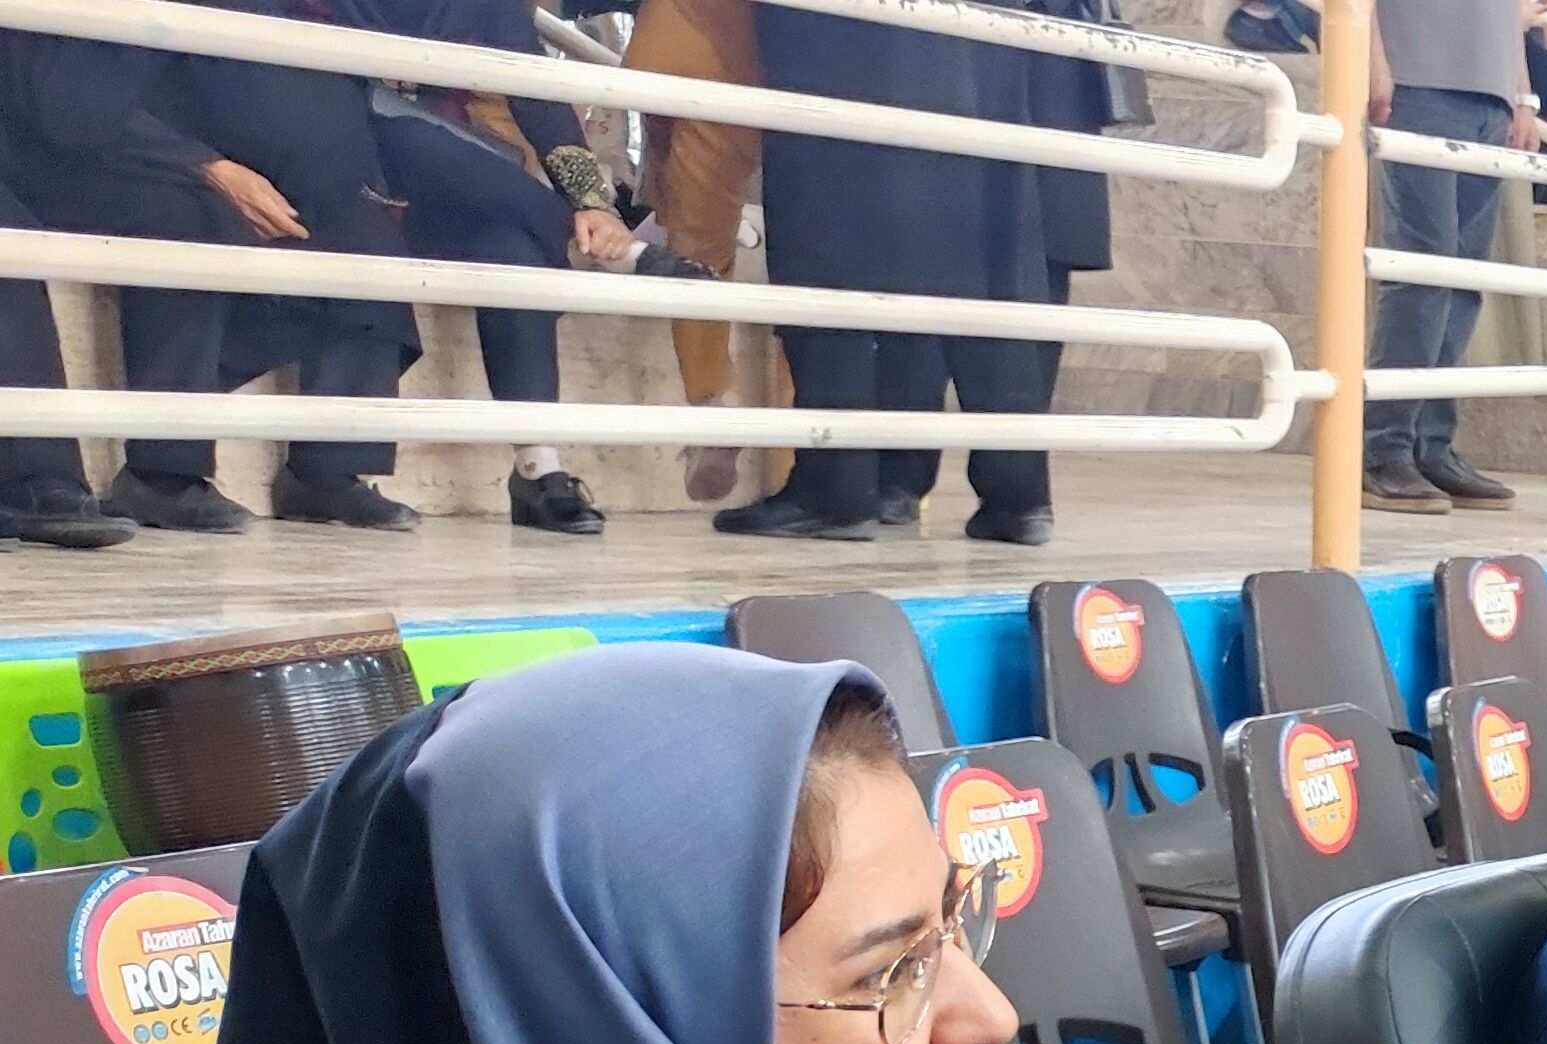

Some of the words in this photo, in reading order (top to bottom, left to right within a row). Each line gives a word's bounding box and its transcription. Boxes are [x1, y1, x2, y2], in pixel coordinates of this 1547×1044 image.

[1298, 772, 1340, 810] ROSA
[959, 825, 1020, 865] ROSA
[142, 923, 200, 951] Azaran
[121, 951, 227, 1013] ROSA
